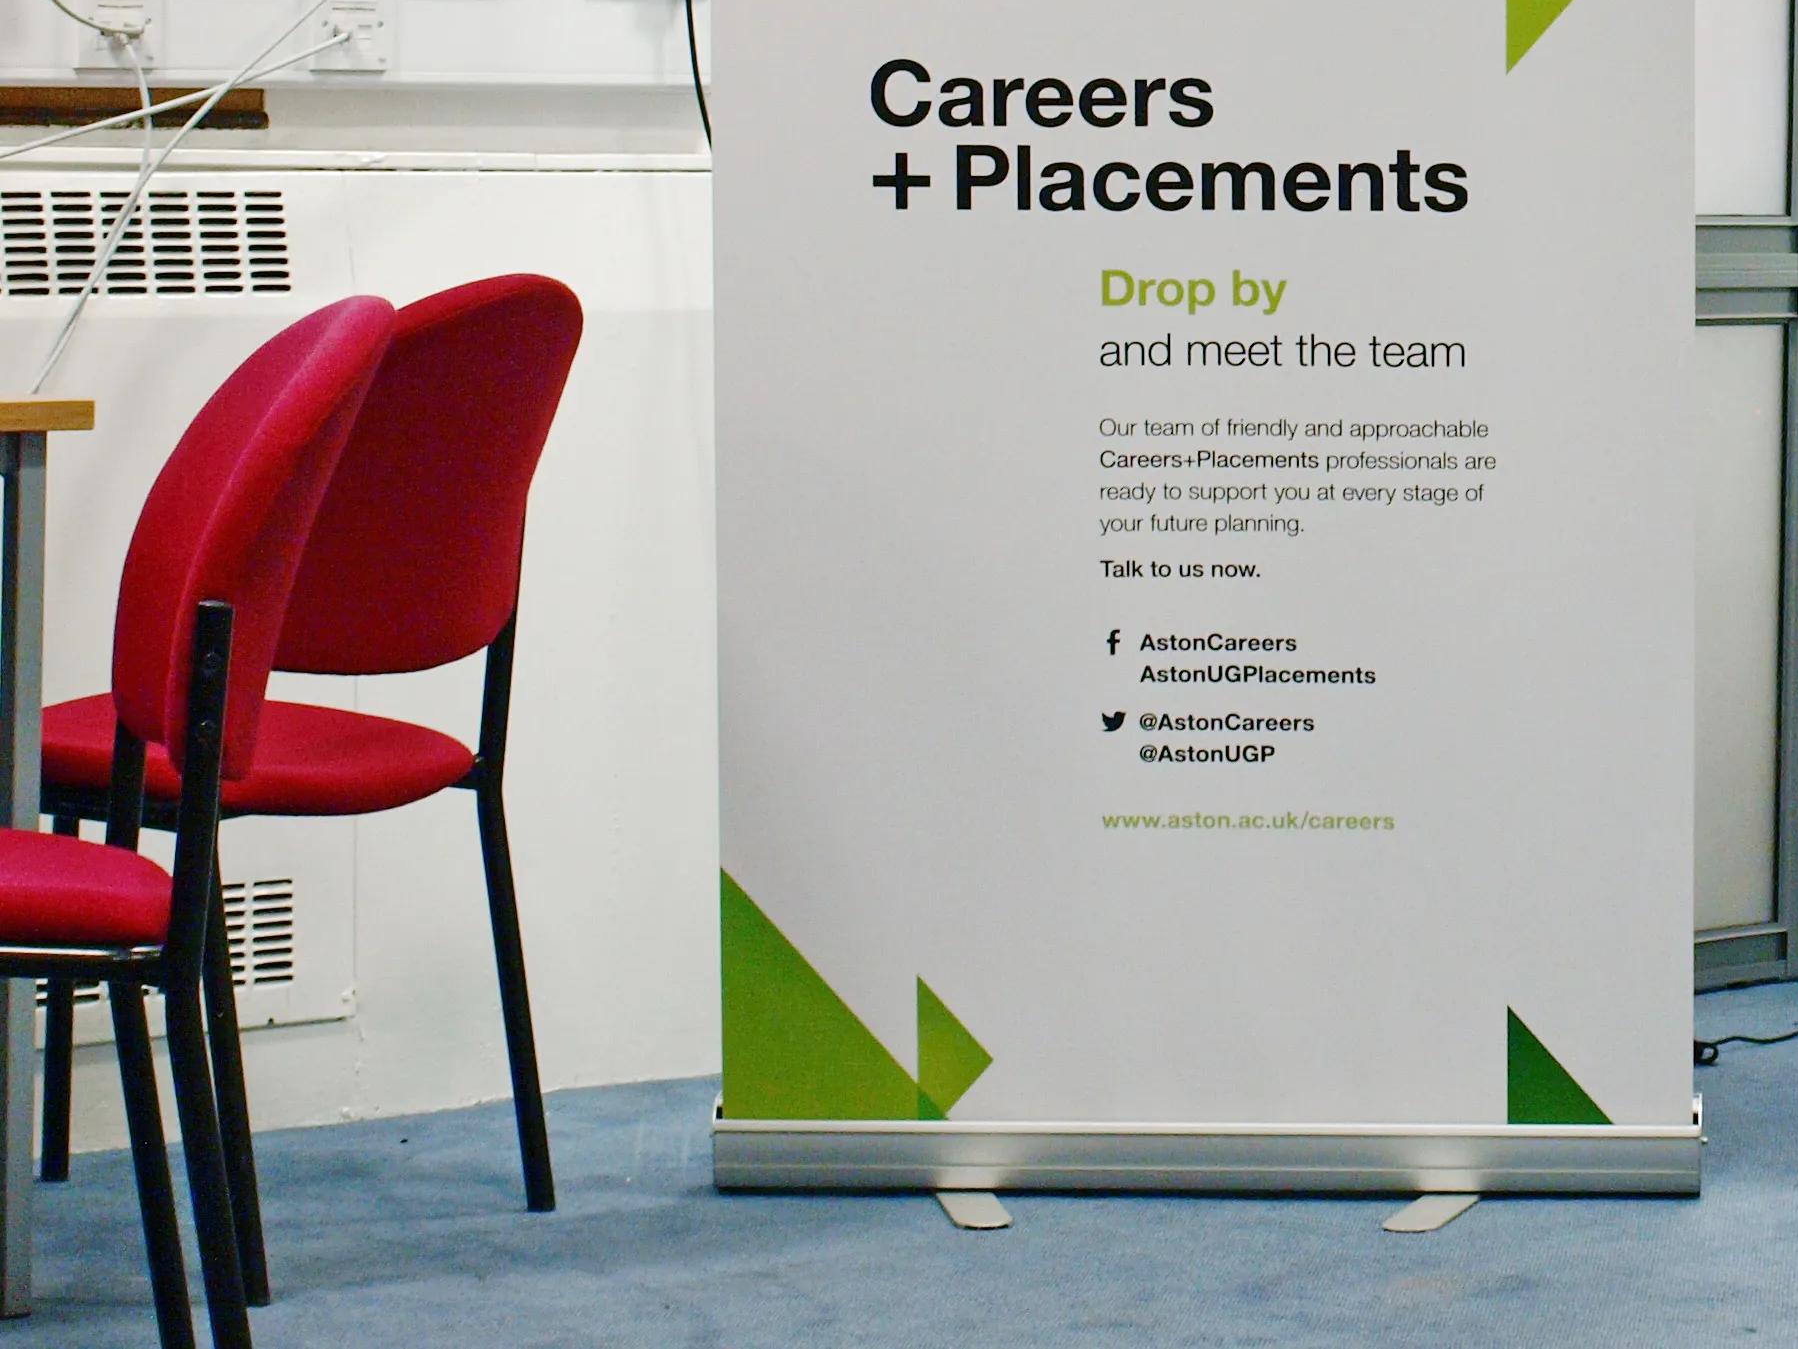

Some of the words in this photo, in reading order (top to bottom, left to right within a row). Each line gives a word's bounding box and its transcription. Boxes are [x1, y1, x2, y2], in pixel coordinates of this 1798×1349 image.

[871, 59, 1214, 128] Careers
[872, 152, 931, 210] +
[956, 144, 1468, 213] Placements
[1101, 269, 1216, 315] Drop
[1232, 269, 1288, 316] by
[1100, 333, 1171, 367] and
[1187, 335, 1283, 367] meet
[1296, 333, 1356, 367] the
[1369, 336, 1465, 368] team
[1099, 419, 1137, 437] Our
[1144, 420, 1194, 437] team
[1201, 418, 1221, 437] of
[1227, 418, 1298, 441] friendly
[1305, 419, 1343, 437] and
[1350, 419, 1489, 442] approachable
[1100, 450, 1319, 469] Careers+Placements
[1326, 451, 1458, 473] professionals
[1465, 455, 1497, 470] are
[1100, 481, 1156, 504] ready
[1163, 483, 1182, 501] to
[1189, 483, 1267, 505] support
[1273, 486, 1310, 505] you
[1317, 484, 1335, 501] at
[1342, 486, 1396, 505] every
[1403, 485, 1459, 505] stage
[1465, 483, 1485, 502] of
[1100, 518, 1144, 536] your
[1150, 513, 1208, 532] future
[1214, 513, 1305, 537] planning.
[1100, 559, 1144, 578] Talk
[1150, 560, 1172, 578] to
[1179, 563, 1205, 578] us
[1211, 563, 1261, 578] now.
[1140, 633, 1297, 652] AstonCareers
[1140, 664, 1376, 685] AstonUGPlacements
[1139, 712, 1315, 732] @AstonCareers
[1139, 744, 1276, 764] @AstonUGP
[1101, 811, 1396, 831] www.aston.ac.uk/careers
